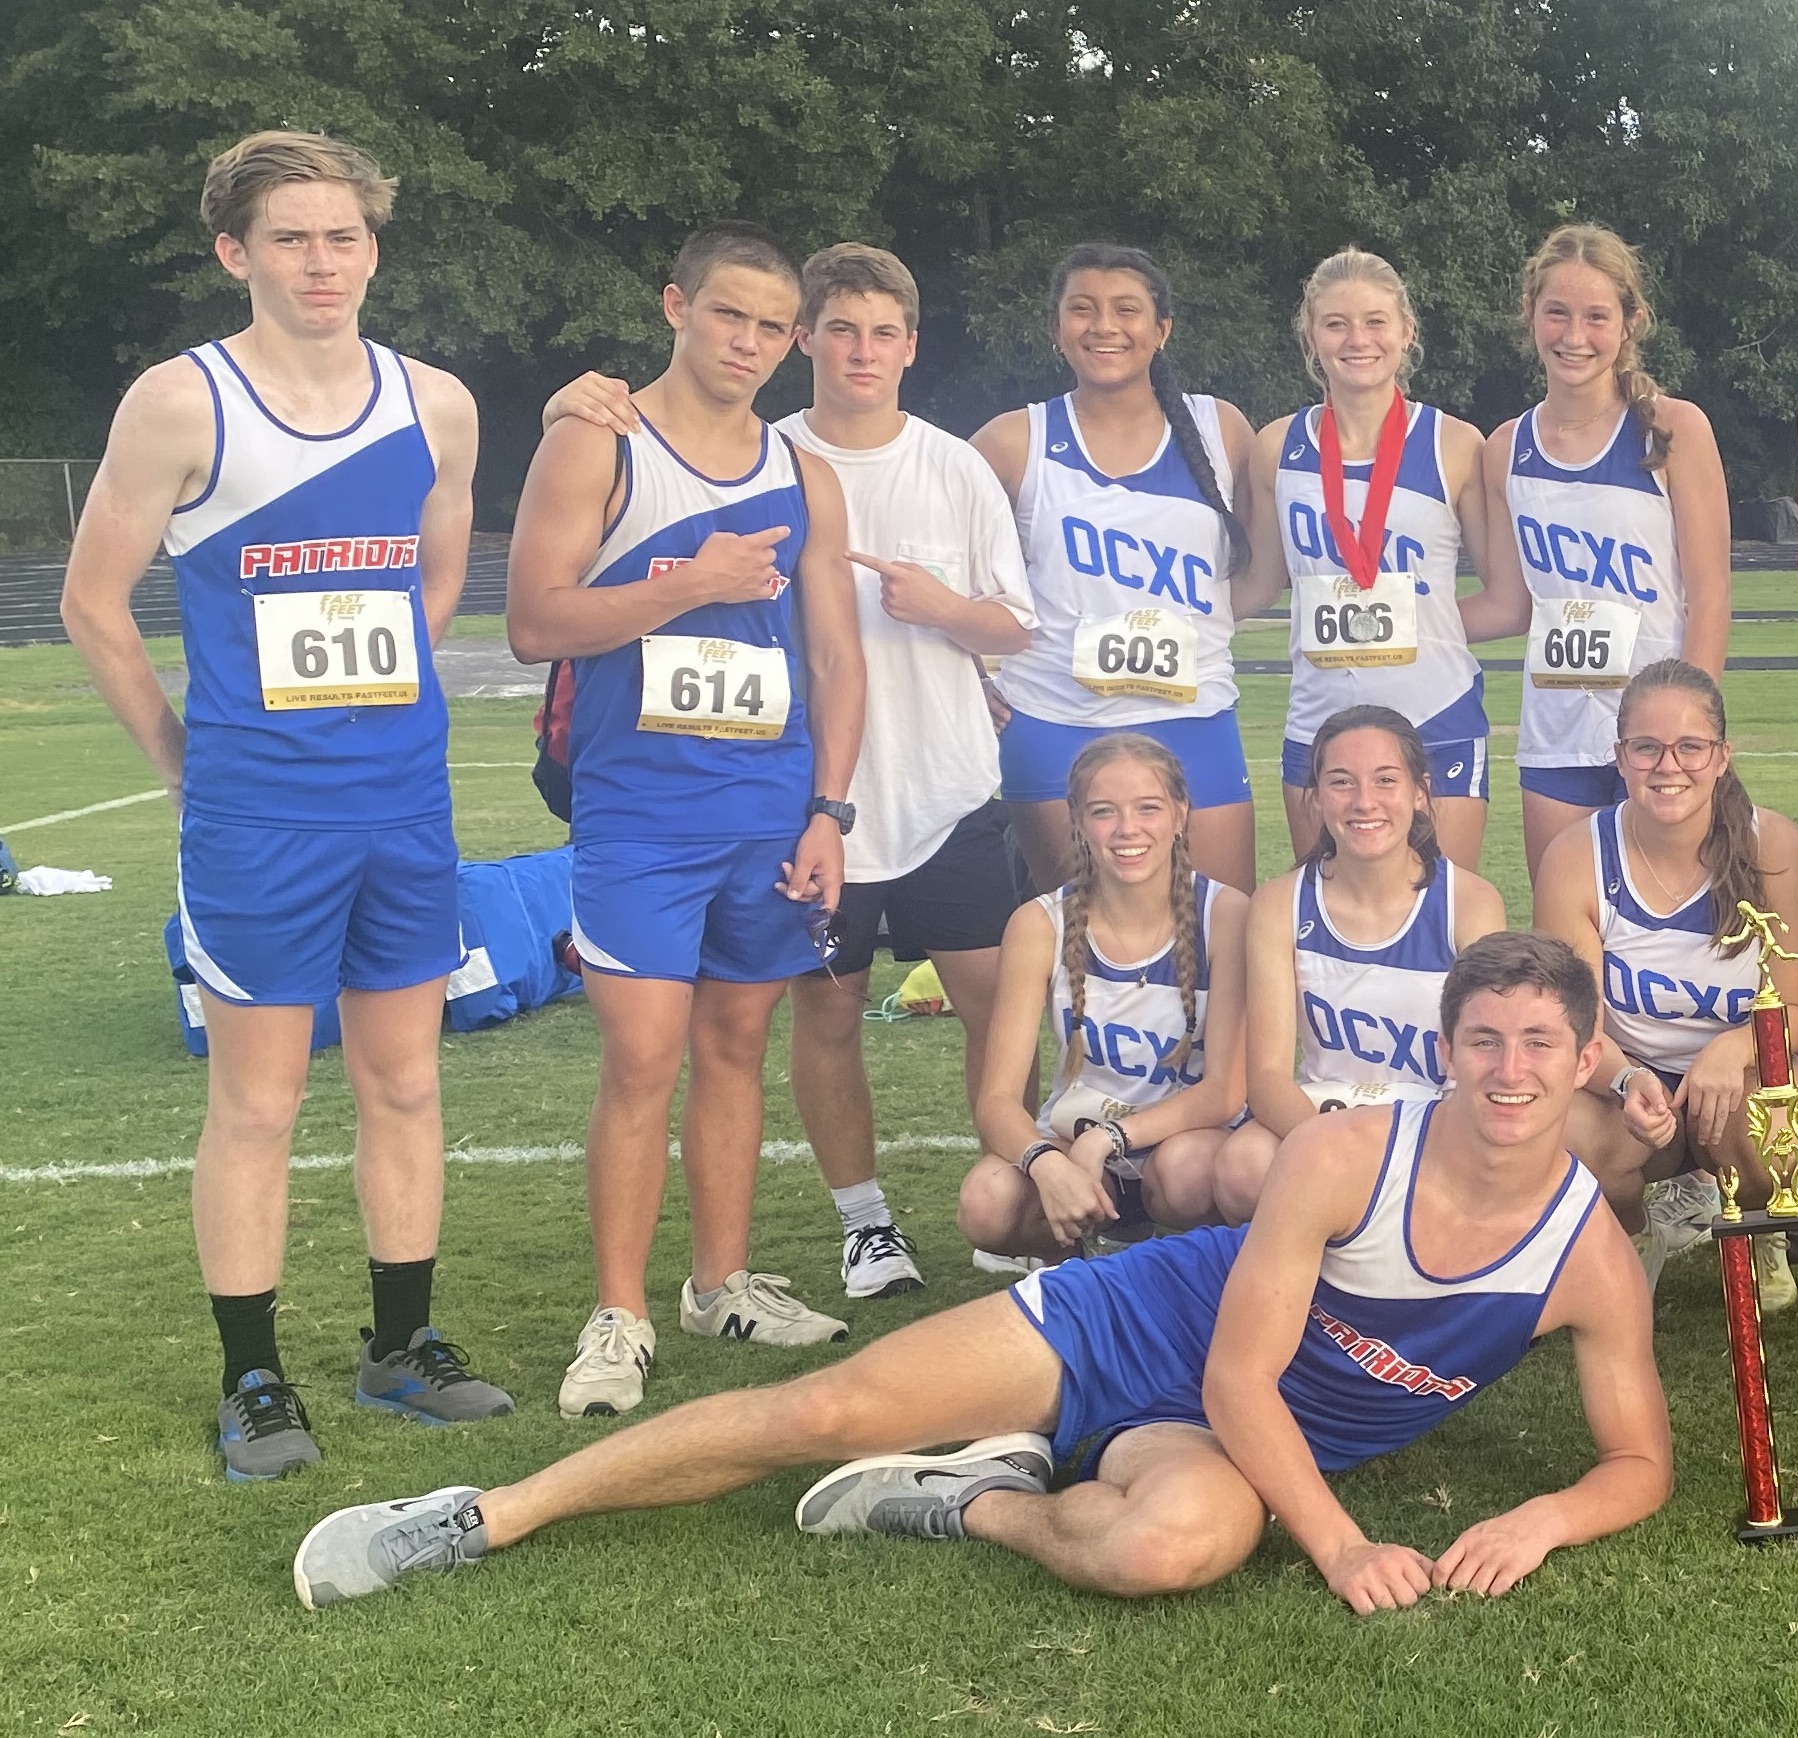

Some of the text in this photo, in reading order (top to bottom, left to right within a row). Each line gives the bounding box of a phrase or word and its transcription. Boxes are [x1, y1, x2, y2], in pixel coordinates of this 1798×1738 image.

[1062, 515, 1212, 615] OCXC
[1517, 515, 1657, 603] OCXC
[327, 603, 366, 625] FEET
[1129, 617, 1160, 631] FEET
[1566, 610, 1595, 626] FEET
[291, 627, 397, 679] 610
[703, 650, 737, 665] FEET
[1098, 633, 1179, 678] 603
[1545, 628, 1611, 669] 605
[310, 692, 353, 701] RESULTS
[671, 667, 764, 716] 614
[1603, 950, 1755, 1024] OCXC
[1309, 1303, 1477, 1401] PATRIOTS
